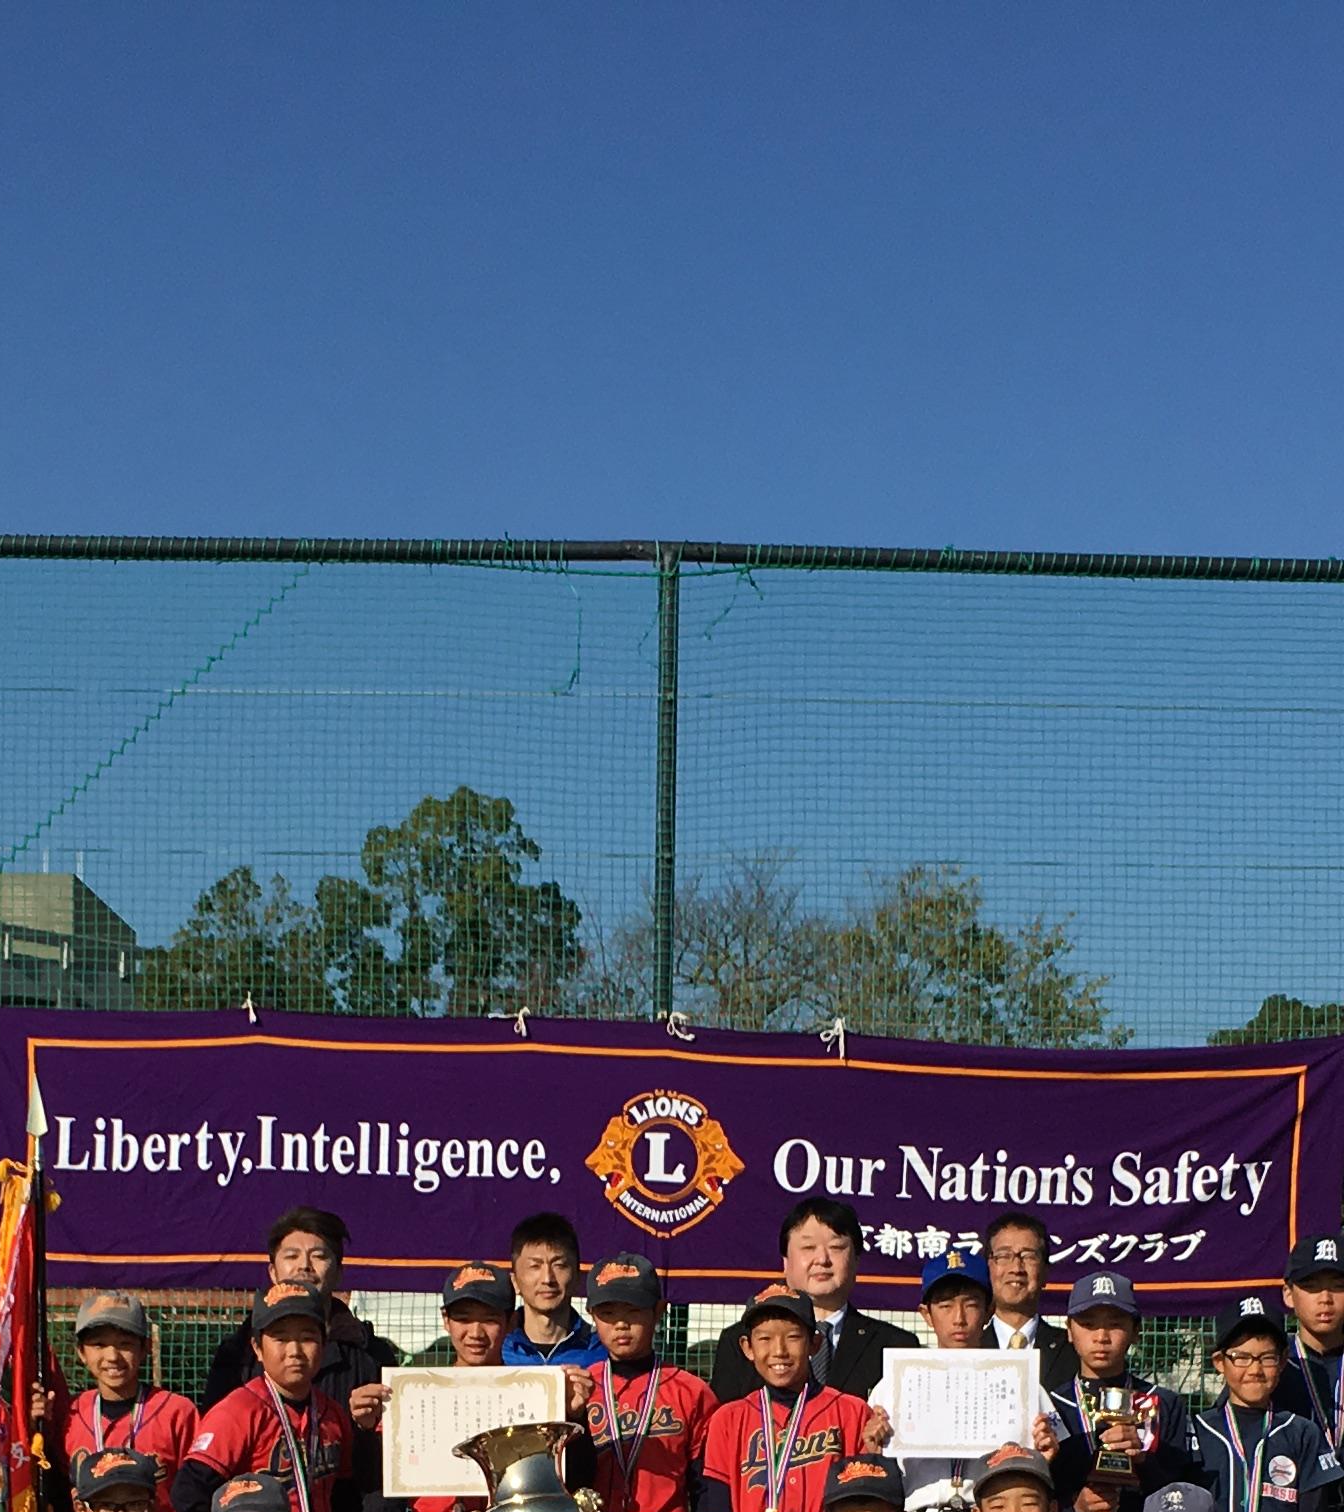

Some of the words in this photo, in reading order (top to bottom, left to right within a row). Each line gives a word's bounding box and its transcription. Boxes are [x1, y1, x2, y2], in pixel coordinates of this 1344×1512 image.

[629, 1096, 703, 1126] LIONS
[644, 1132, 686, 1184] L
[773, 1138, 886, 1197] Our
[896, 1145, 1094, 1206] Nation's
[1109, 1151, 1273, 1215] Safety
[618, 1189, 710, 1223] INTERNATIONAL
